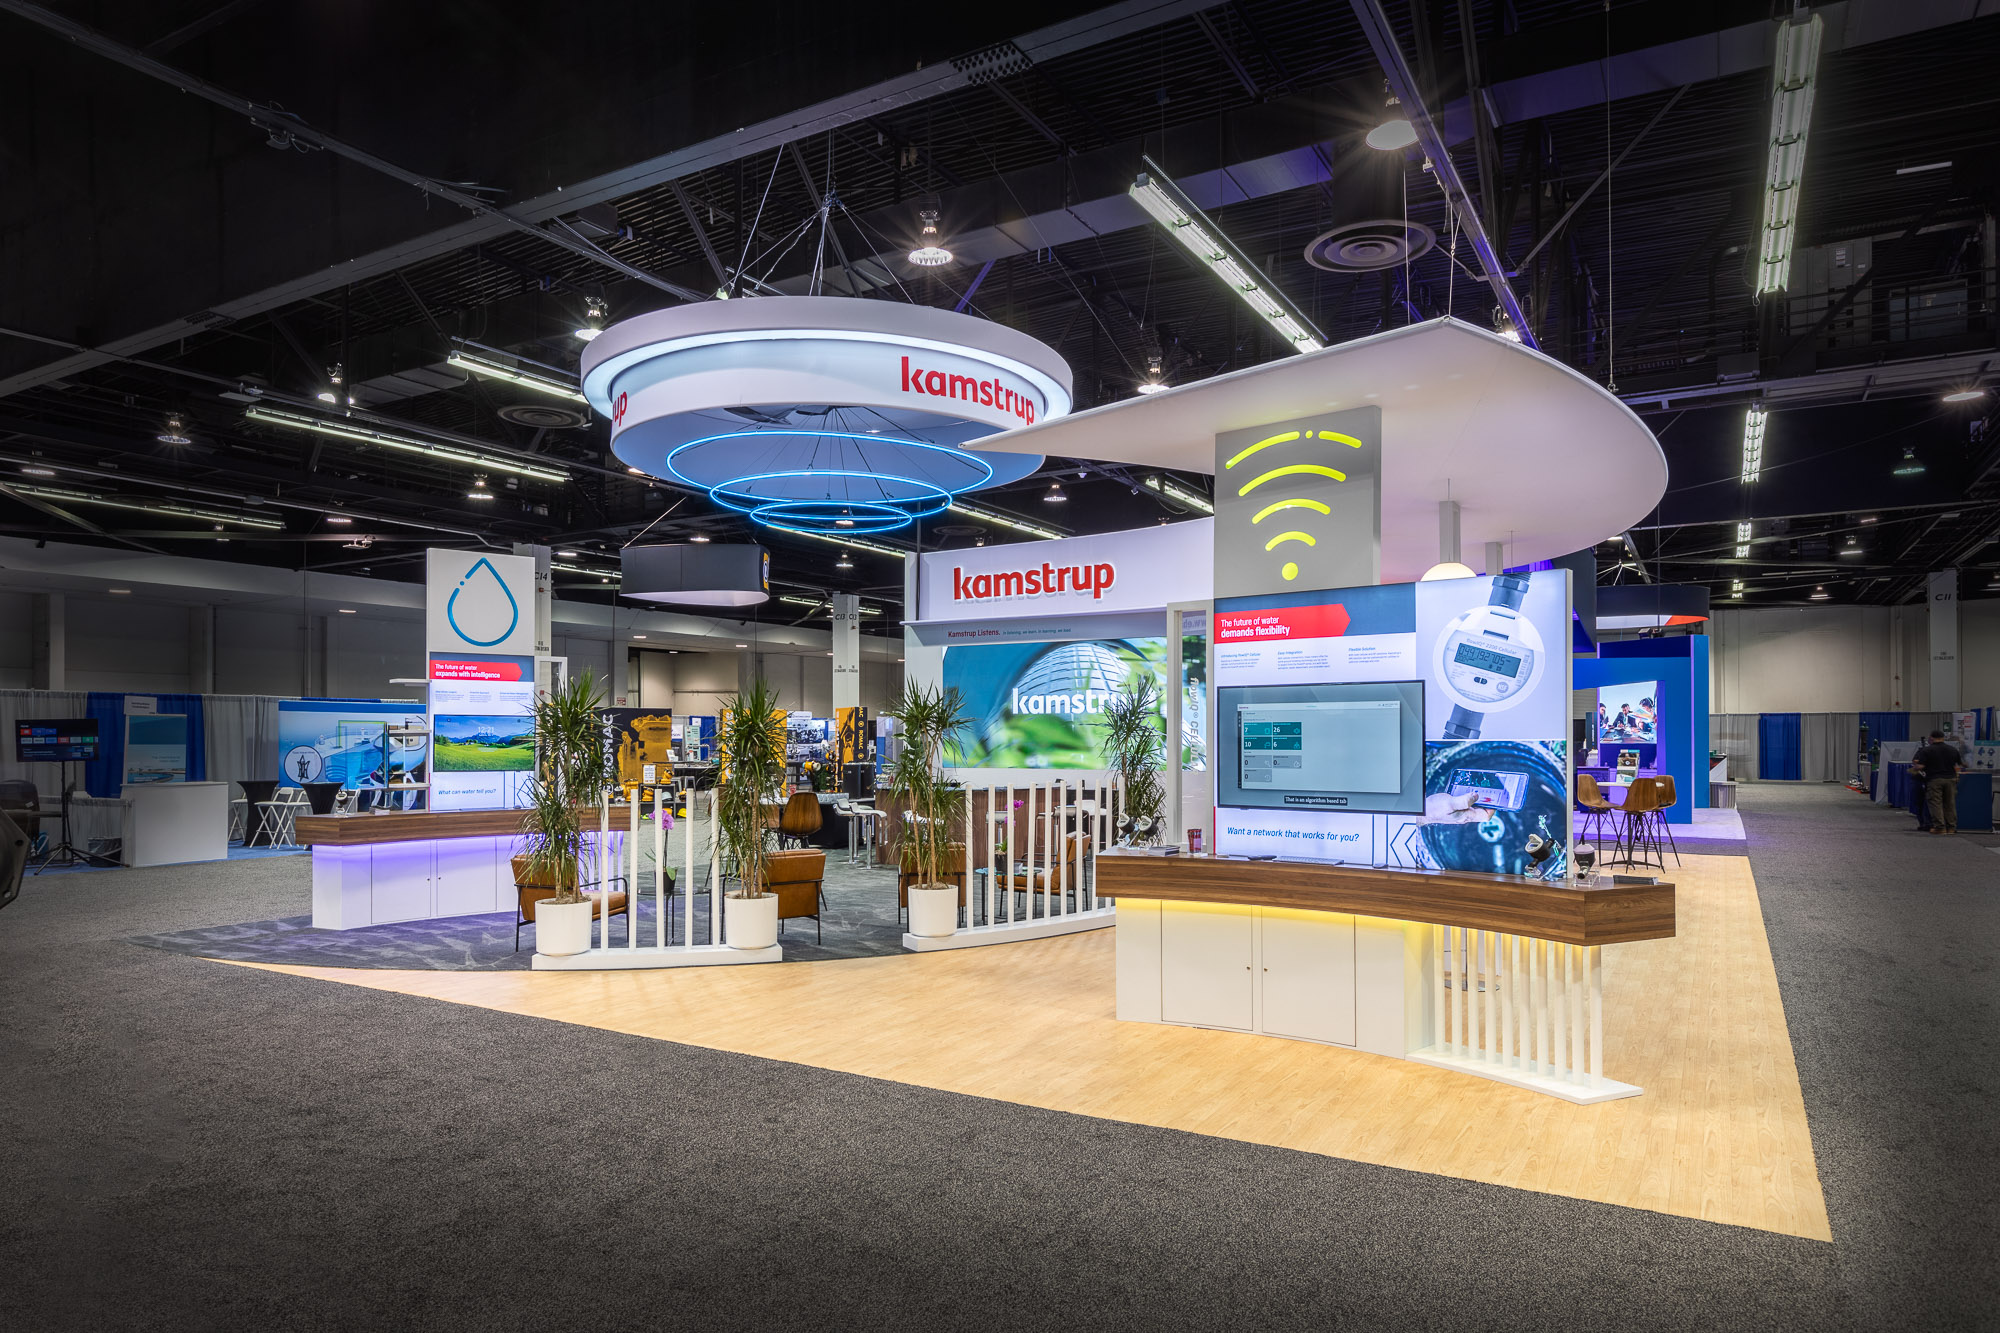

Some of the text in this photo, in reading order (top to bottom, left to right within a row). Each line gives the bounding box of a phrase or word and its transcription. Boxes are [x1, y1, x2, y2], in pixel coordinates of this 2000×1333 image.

[901, 356, 1034, 426] kamstrup
[953, 562, 1115, 600] kamstrup
[1233, 618, 1252, 626] future
[1253, 616, 1260, 625] of
[1261, 616, 1279, 624] water
[948, 630, 976, 638] Kamstrup
[1221, 625, 1290, 638] demands flexibility
[1228, 827, 1245, 835] Want
[1253, 829, 1283, 837] network
[1285, 830, 1300, 838] that
[1302, 831, 1324, 840] works
[1327, 832, 1338, 840] for
[1340, 834, 1360, 842] you?
